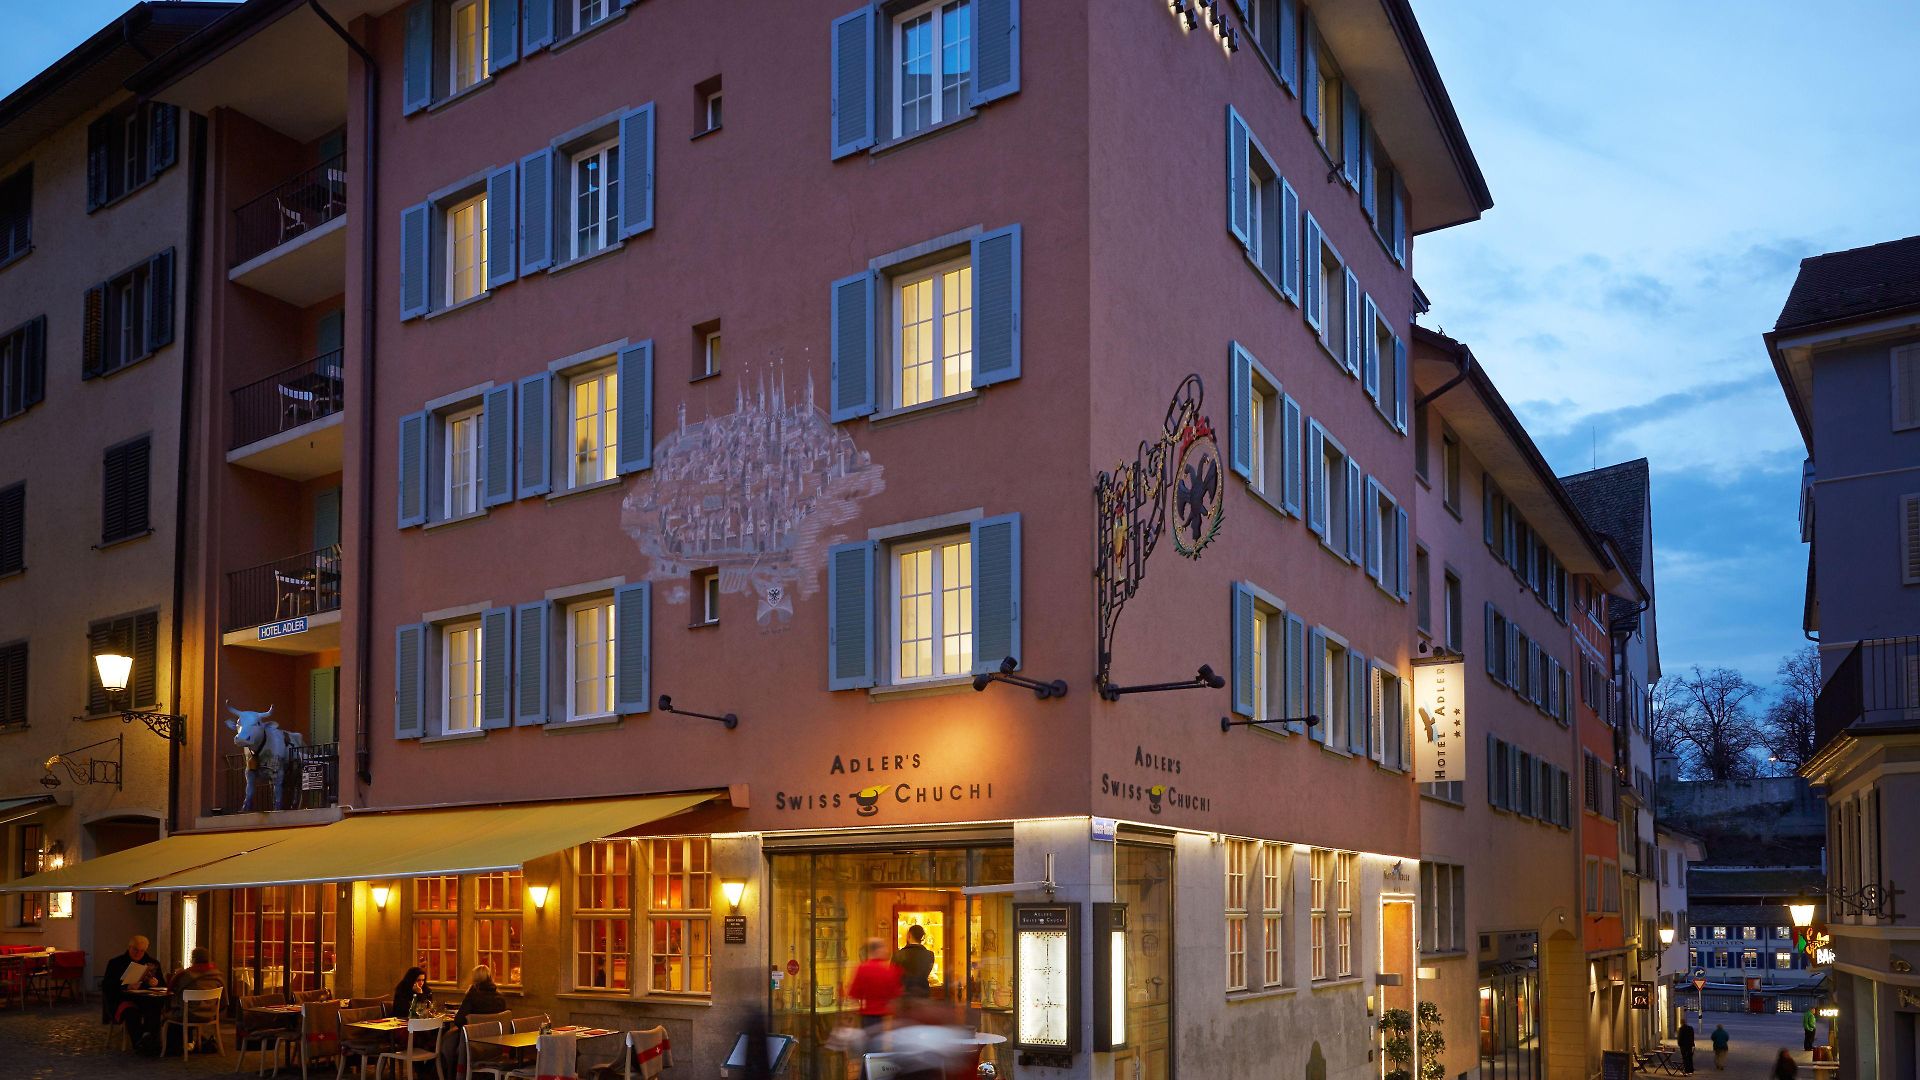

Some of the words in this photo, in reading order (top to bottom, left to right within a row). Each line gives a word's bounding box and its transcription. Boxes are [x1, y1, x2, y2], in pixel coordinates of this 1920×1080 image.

[261, 625, 281, 638] HOTEL
[282, 620, 304, 632] ADLER
[1434, 667, 1446, 717] ADLER
[830, 753, 921, 775] ADLER'S
[1134, 745, 1181, 774] ADLER'S
[1434, 731, 1446, 780] HOTEL
[775, 791, 841, 810] SWISS
[895, 783, 992, 803] CHUCHI
[1102, 773, 1142, 801] SWISS
[1168, 786, 1210, 812] CHUCHI
[1816, 948, 1836, 965] BAR
